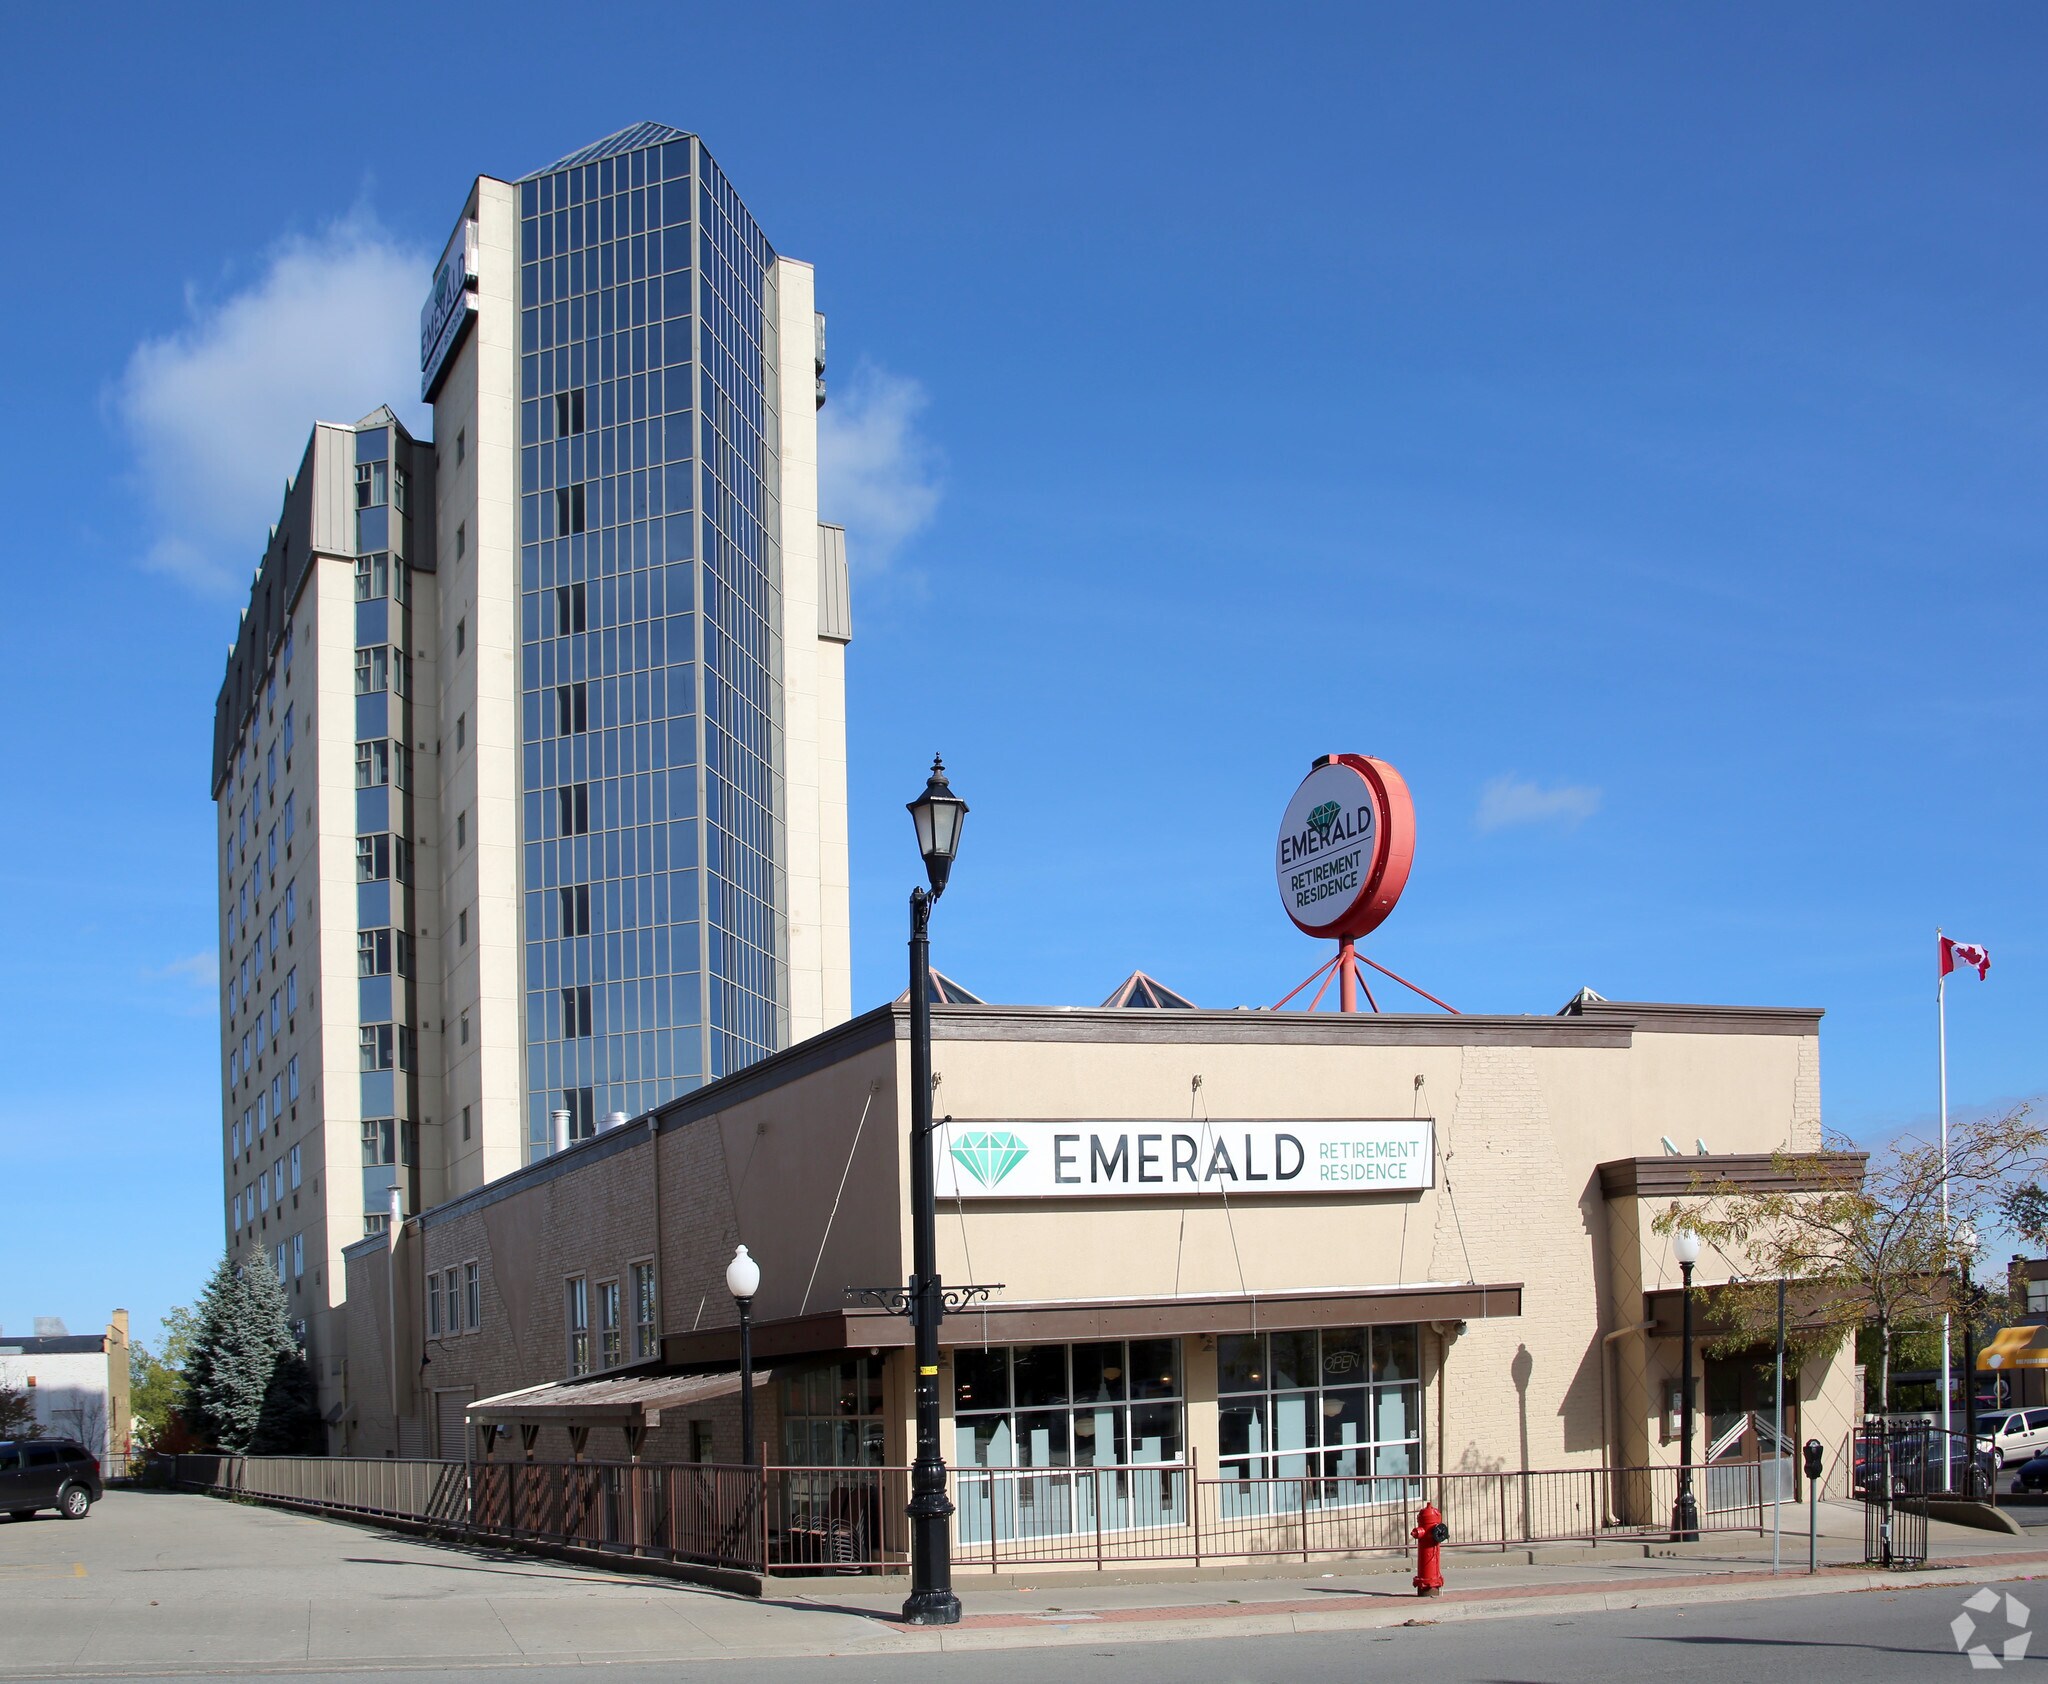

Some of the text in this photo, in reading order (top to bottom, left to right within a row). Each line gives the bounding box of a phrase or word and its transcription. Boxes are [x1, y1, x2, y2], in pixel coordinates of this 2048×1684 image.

[422, 252, 465, 361] EMERALD
[1281, 806, 1371, 865] EMERALD
[1291, 850, 1361, 891] RETIREMENT
[1296, 871, 1358, 908] RESIDENCE
[1054, 1133, 1305, 1184] EMERALD
[1320, 1141, 1419, 1159] RETIREMENT
[1320, 1163, 1407, 1180] RESIDENCE
[1324, 1353, 1360, 1370] OPEN
